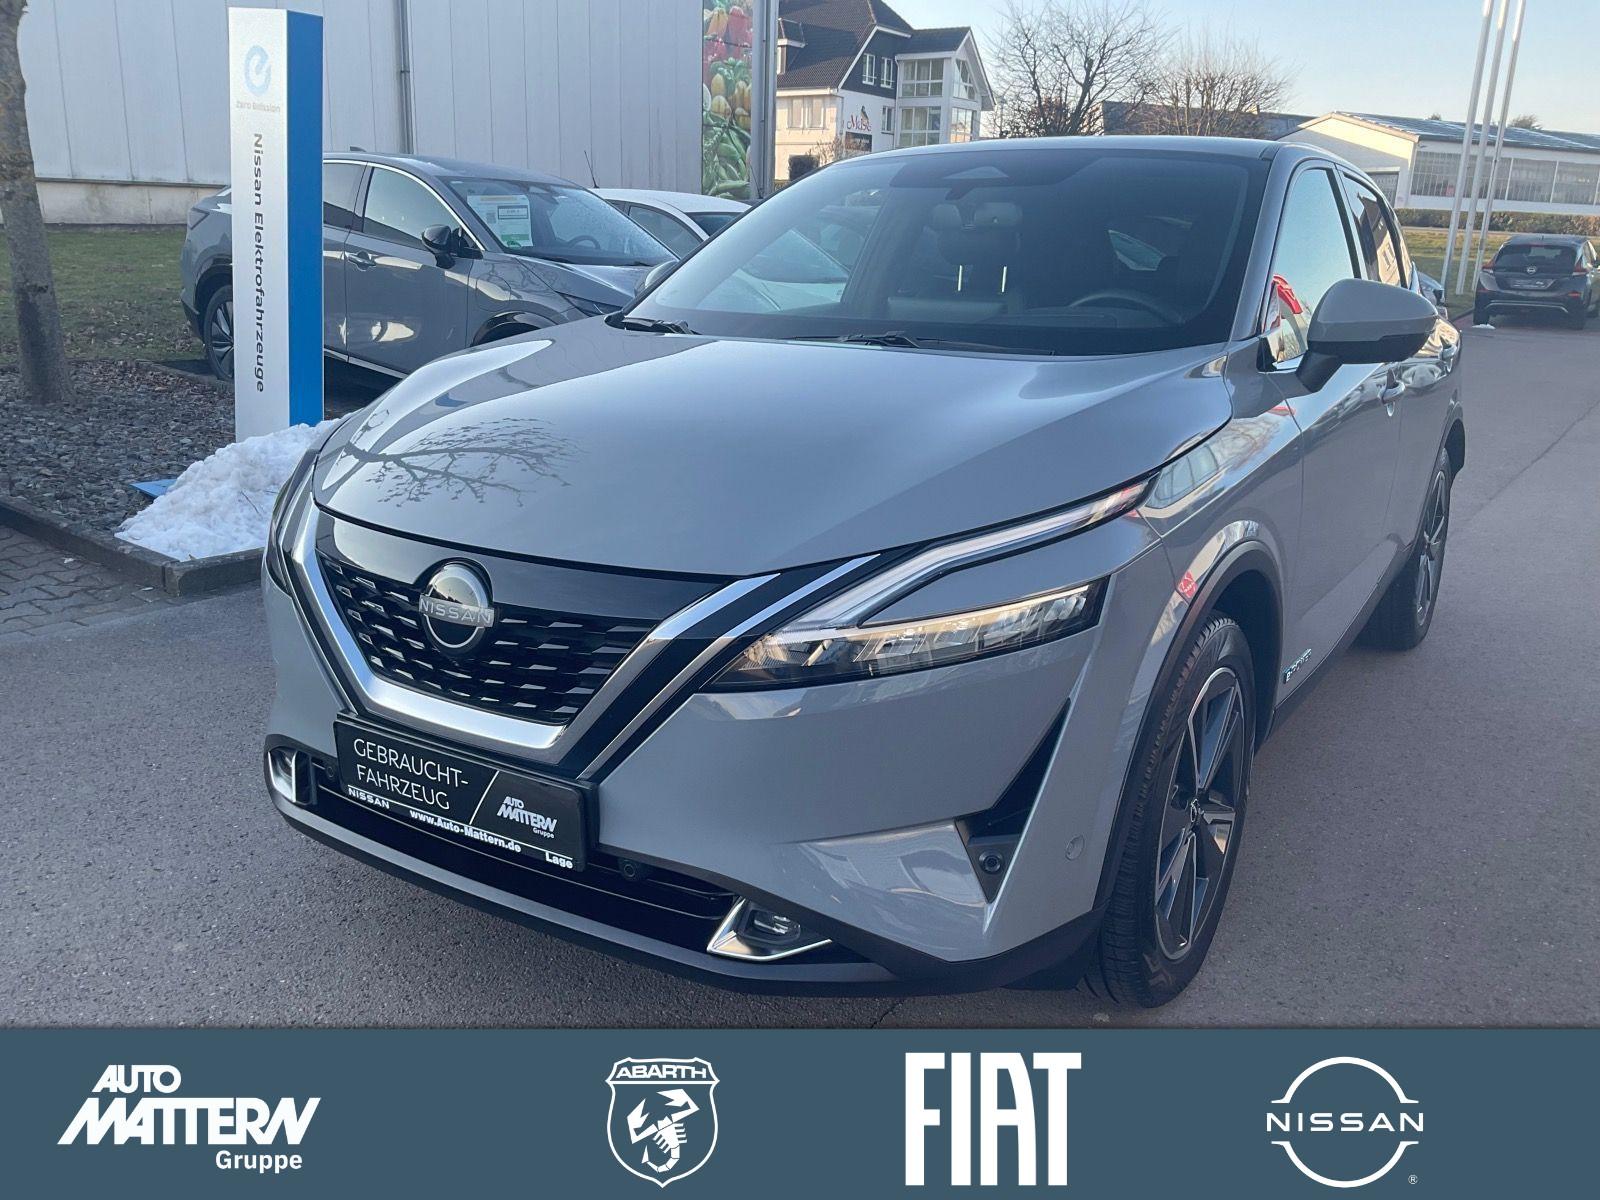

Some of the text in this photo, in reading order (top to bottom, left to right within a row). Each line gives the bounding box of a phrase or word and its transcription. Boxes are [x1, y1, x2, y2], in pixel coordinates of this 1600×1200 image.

[254, 133, 265, 393] Nissan Elektrofahrzeuge
[419, 598, 492, 624] NISSAN
[353, 738, 469, 788] GEBRAUCHT-
[347, 787, 390, 810] NISSAN
[356, 764, 450, 810] FAHRZEUG
[502, 796, 525, 809] AUTO
[409, 809, 522, 853] www.Auto-Mattern.de
[496, 803, 558, 833] MATTERN
[532, 827, 555, 839] Gruppe
[545, 851, 574, 869] Lage
